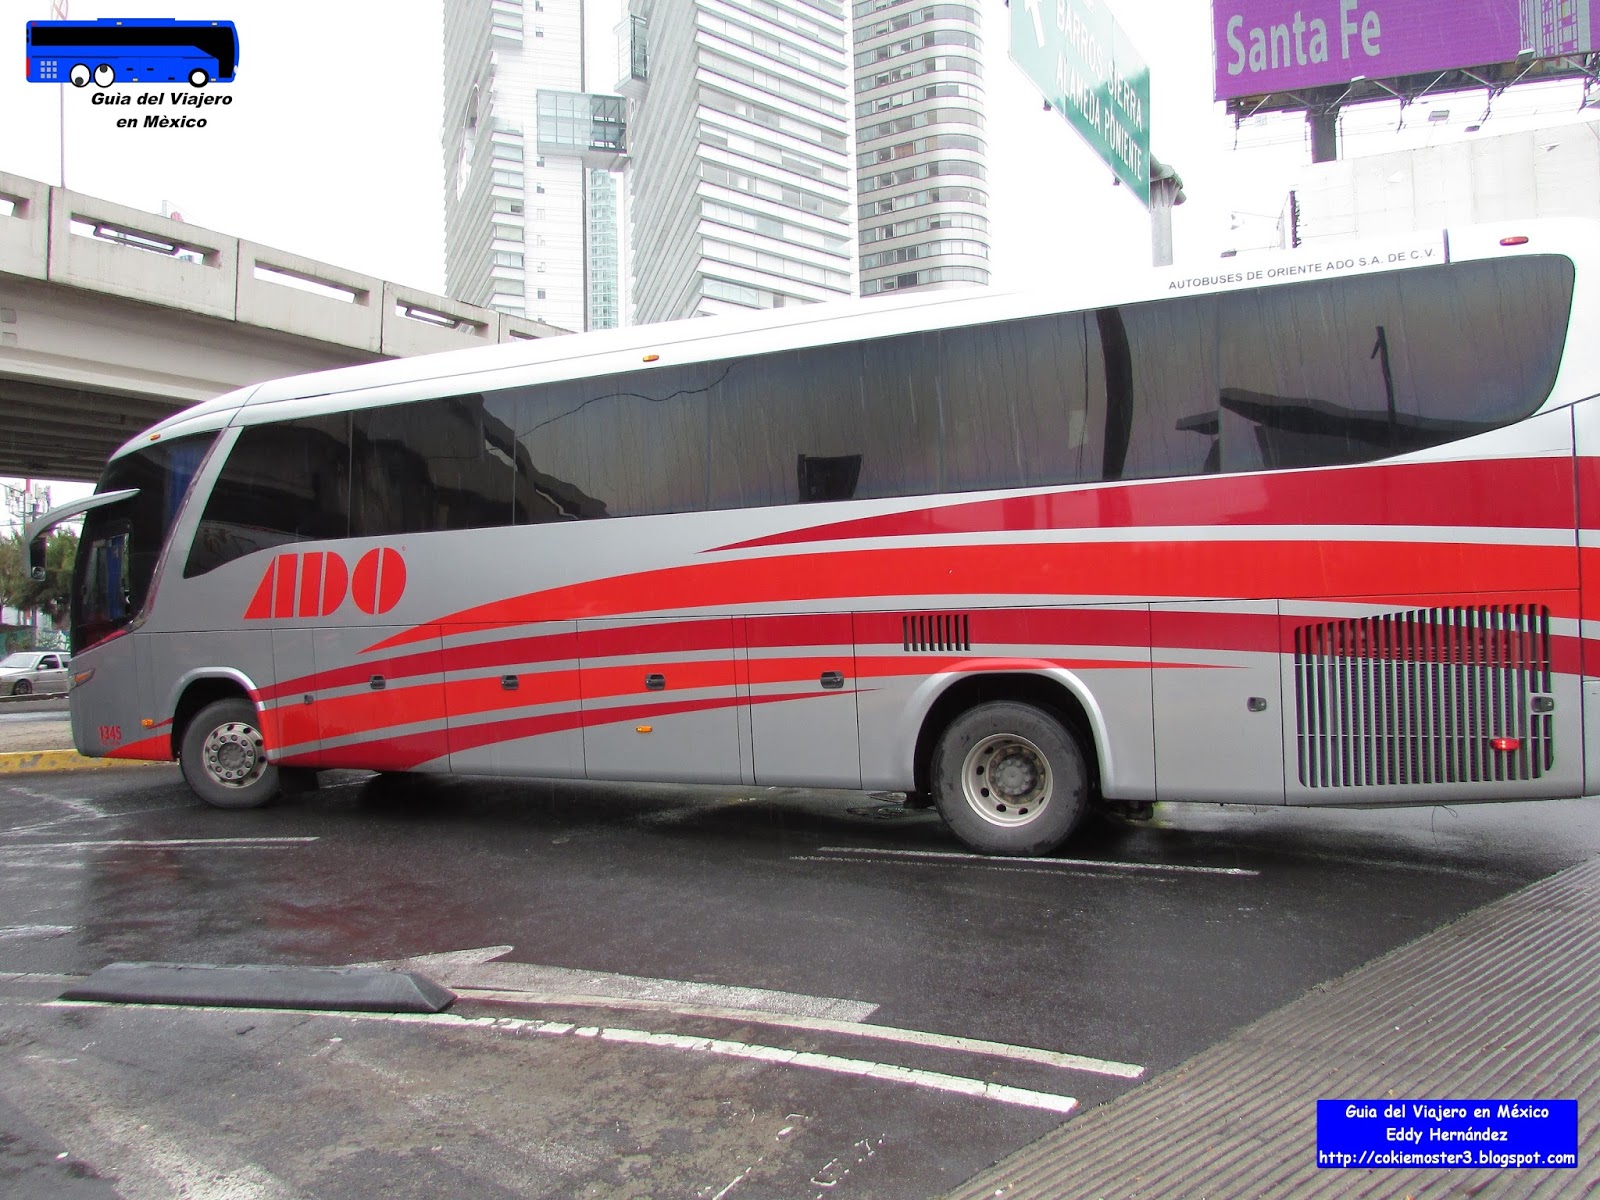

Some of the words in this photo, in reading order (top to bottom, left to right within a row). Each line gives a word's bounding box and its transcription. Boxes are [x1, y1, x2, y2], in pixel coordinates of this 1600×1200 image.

[1056, 0, 1103, 80] BARROS
[1107, 60, 1143, 133] SIERRA
[1226, 10, 1329, 76] Santa
[1339, 0, 1381, 59] Fe
[1056, 51, 1101, 135] ALAMEDA
[1104, 107, 1142, 182] PONIENTE
[1168, 273, 1243, 290] AUTOBUSES
[1247, 270, 1263, 281] DE
[1267, 264, 1323, 278] ORIENTE
[1326, 259, 1355, 270] ADO
[1359, 255, 1384, 267] S.A.
[1388, 252, 1406, 263] DE
[1410, 248, 1436, 260] C.V.
[243, 547, 407, 620] ADO
[99, 725, 121, 741] 1345
